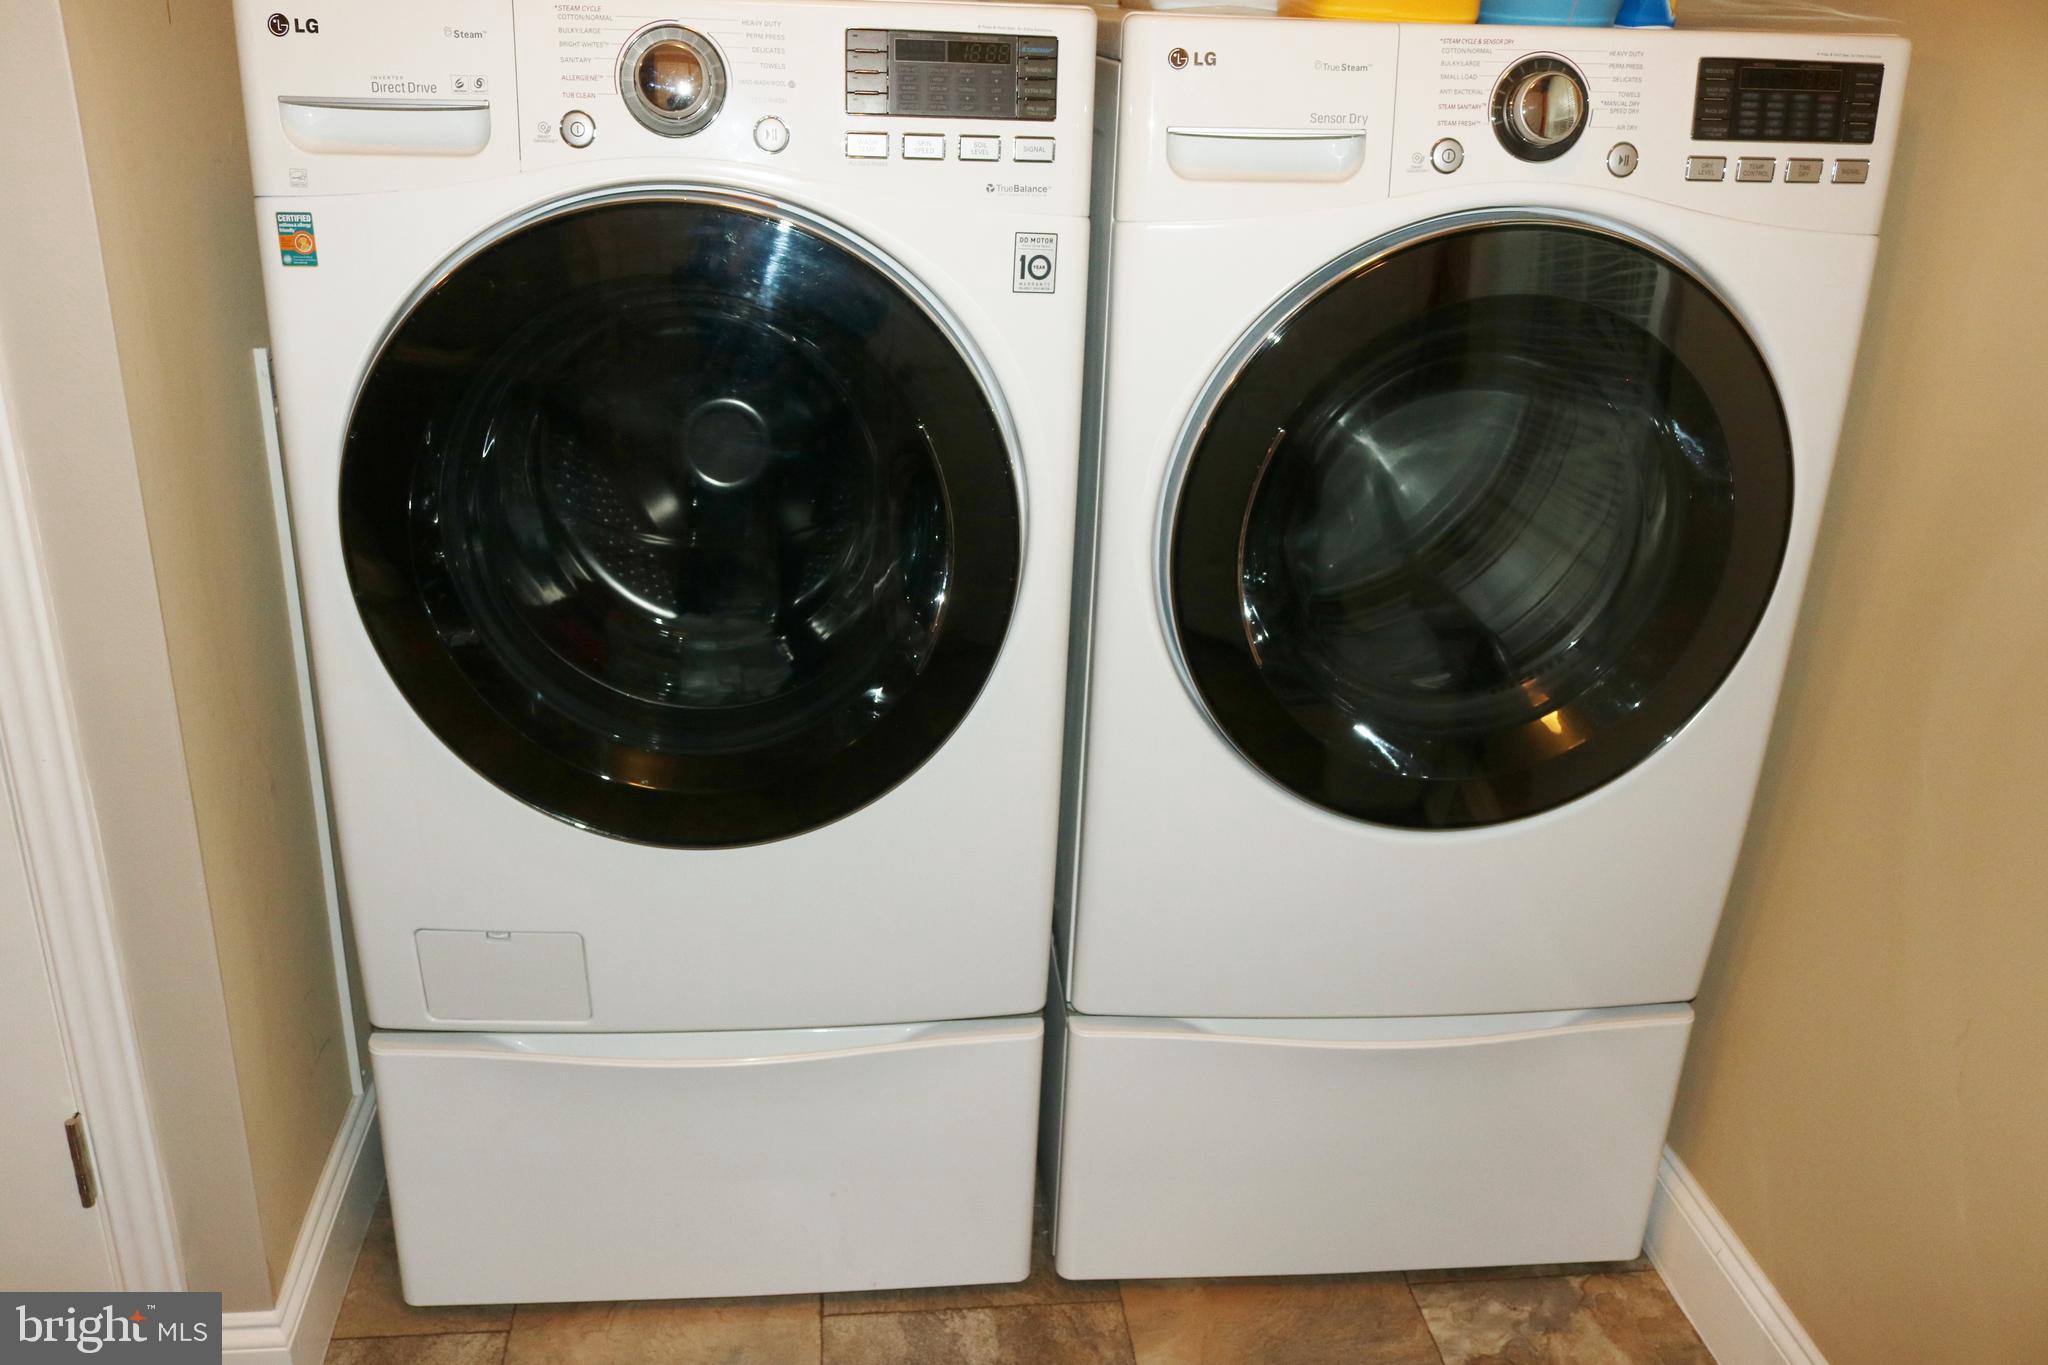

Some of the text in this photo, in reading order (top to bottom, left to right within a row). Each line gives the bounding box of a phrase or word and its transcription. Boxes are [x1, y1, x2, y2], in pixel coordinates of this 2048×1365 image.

[294, 18, 319, 34] LG
[1193, 51, 1217, 66] LG
[759, 62, 787, 70] TOWELS
[1461, 73, 1479, 81] LOAD
[371, 82, 437, 94] Direct Drive
[576, 91, 597, 99] CLEAN
[1309, 113, 1369, 126] Sensor Dry
[1023, 145, 1047, 153] SIGNAL
[278, 213, 312, 223] CERTIFIED
[1019, 254, 1052, 281] 10
